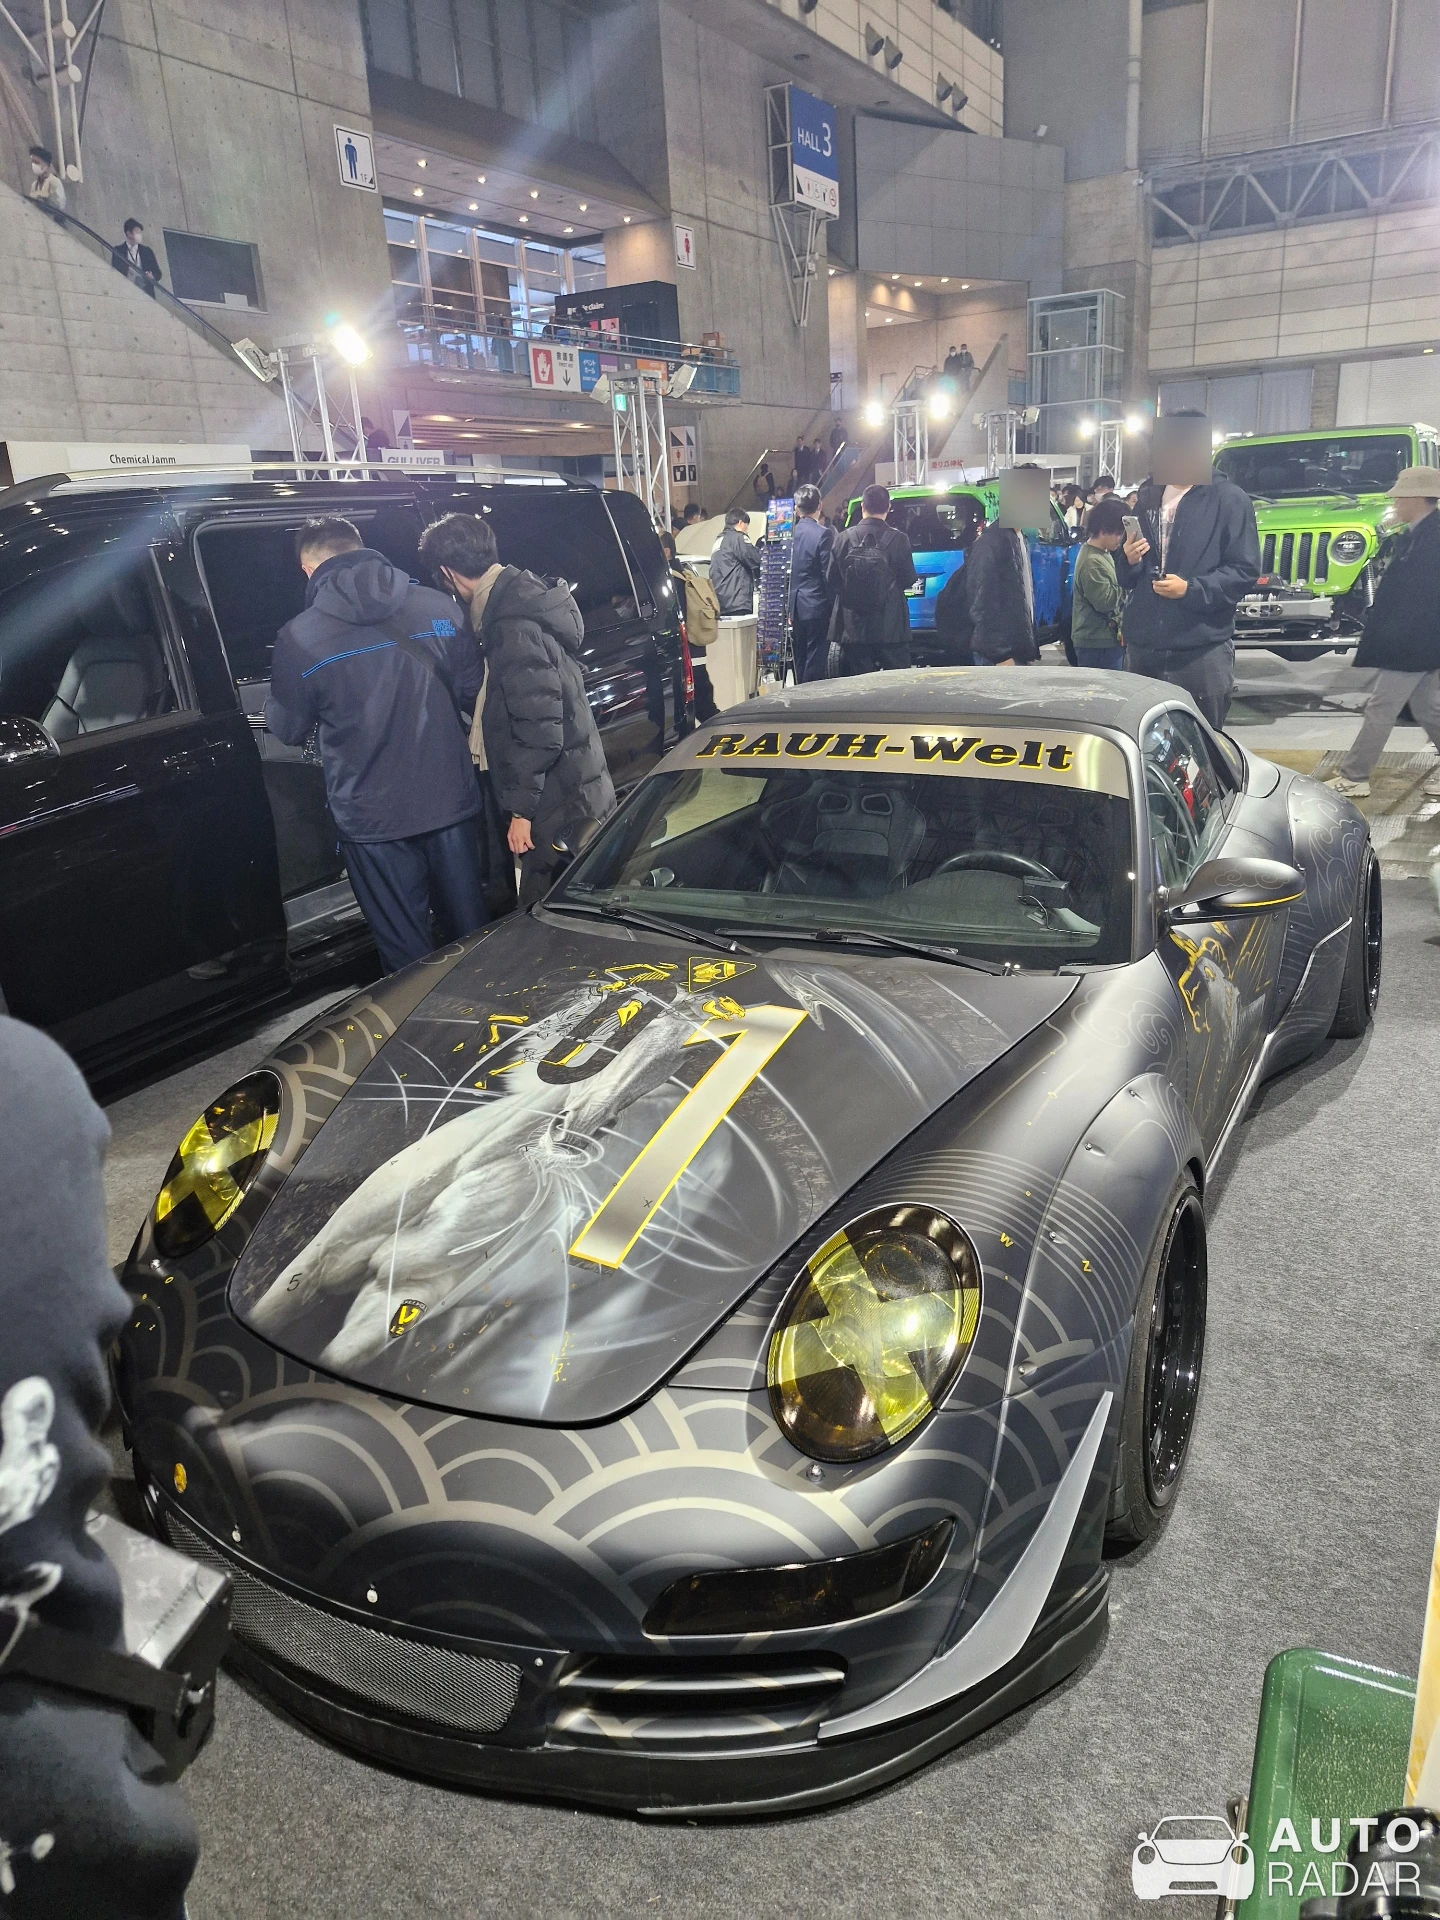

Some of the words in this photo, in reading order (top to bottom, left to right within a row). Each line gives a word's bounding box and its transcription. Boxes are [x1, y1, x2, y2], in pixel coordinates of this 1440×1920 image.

[797, 126, 821, 153] HALL
[822, 122, 832, 157] 3
[109, 454, 150, 464] Chemical
[151, 454, 177, 464] Jamm
[696, 732, 1073, 772] RAUH-Welt
[287, 1273, 302, 1291] 5
